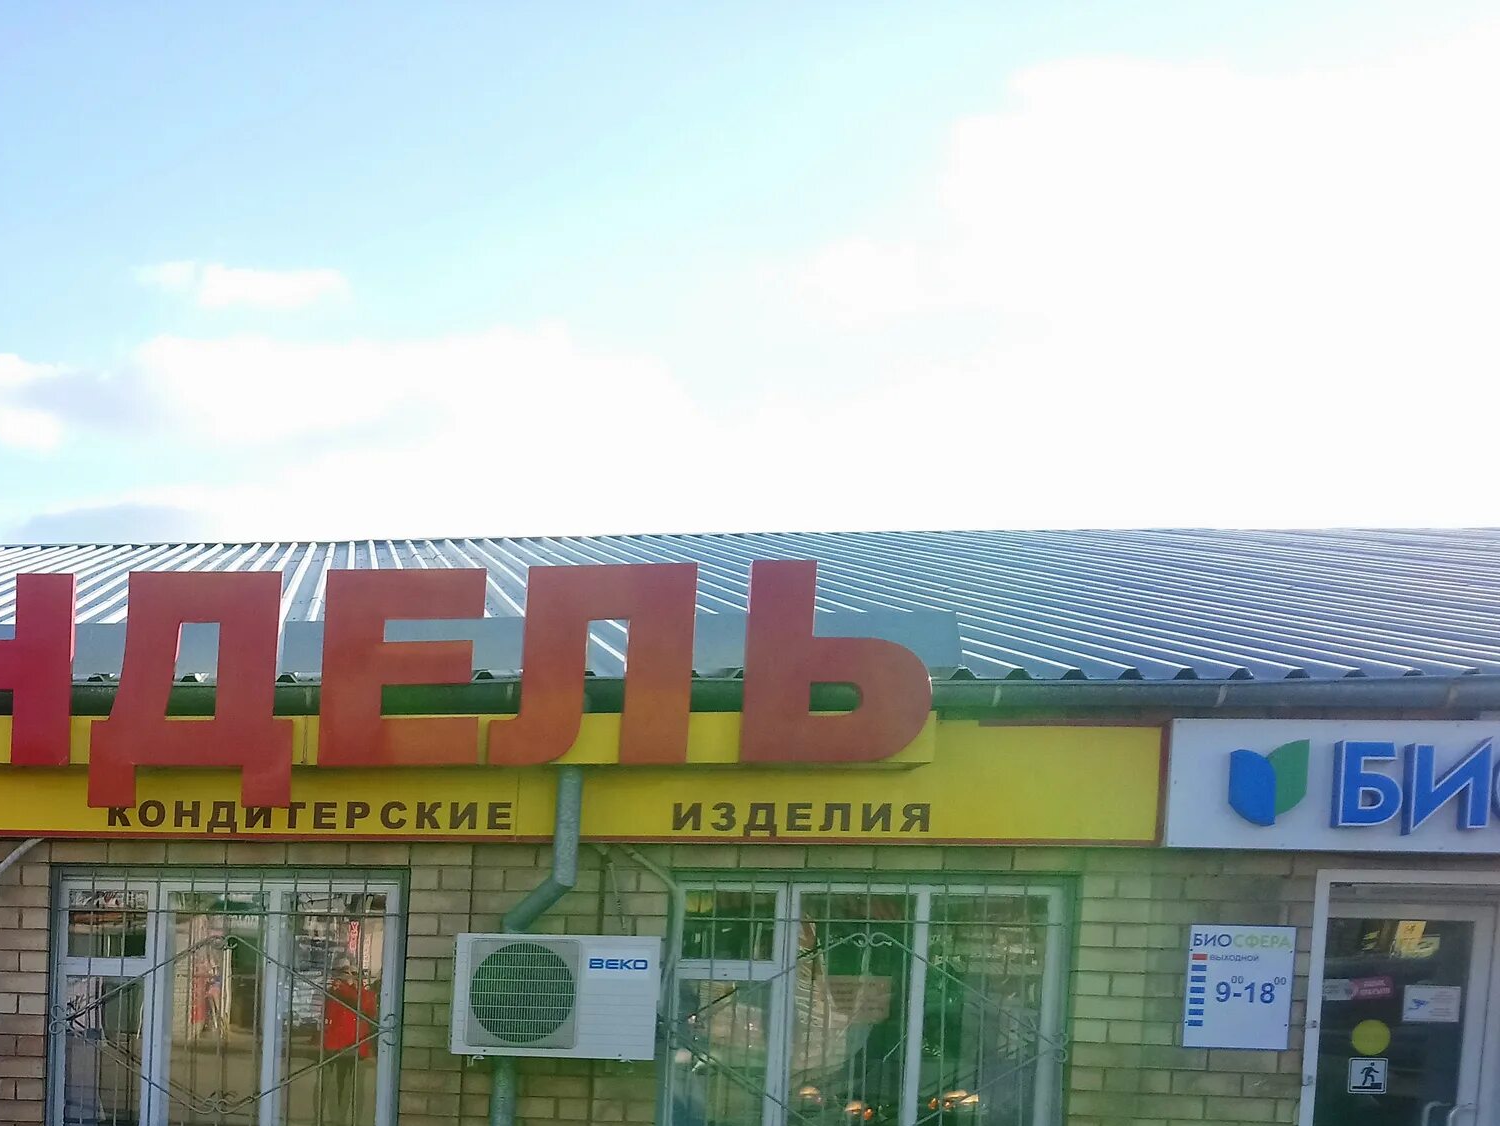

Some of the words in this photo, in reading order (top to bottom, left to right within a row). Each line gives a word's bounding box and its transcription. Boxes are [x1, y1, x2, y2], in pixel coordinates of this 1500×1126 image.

[1330, 736, 1500, 836] БИ
[107, 800, 512, 833] КОНДИТЕРСКИЕ
[672, 802, 931, 836] ИЗДЕЛИЯ
[1193, 933, 1292, 949] БИОСФЕРА
[589, 958, 648, 970] BEKO
